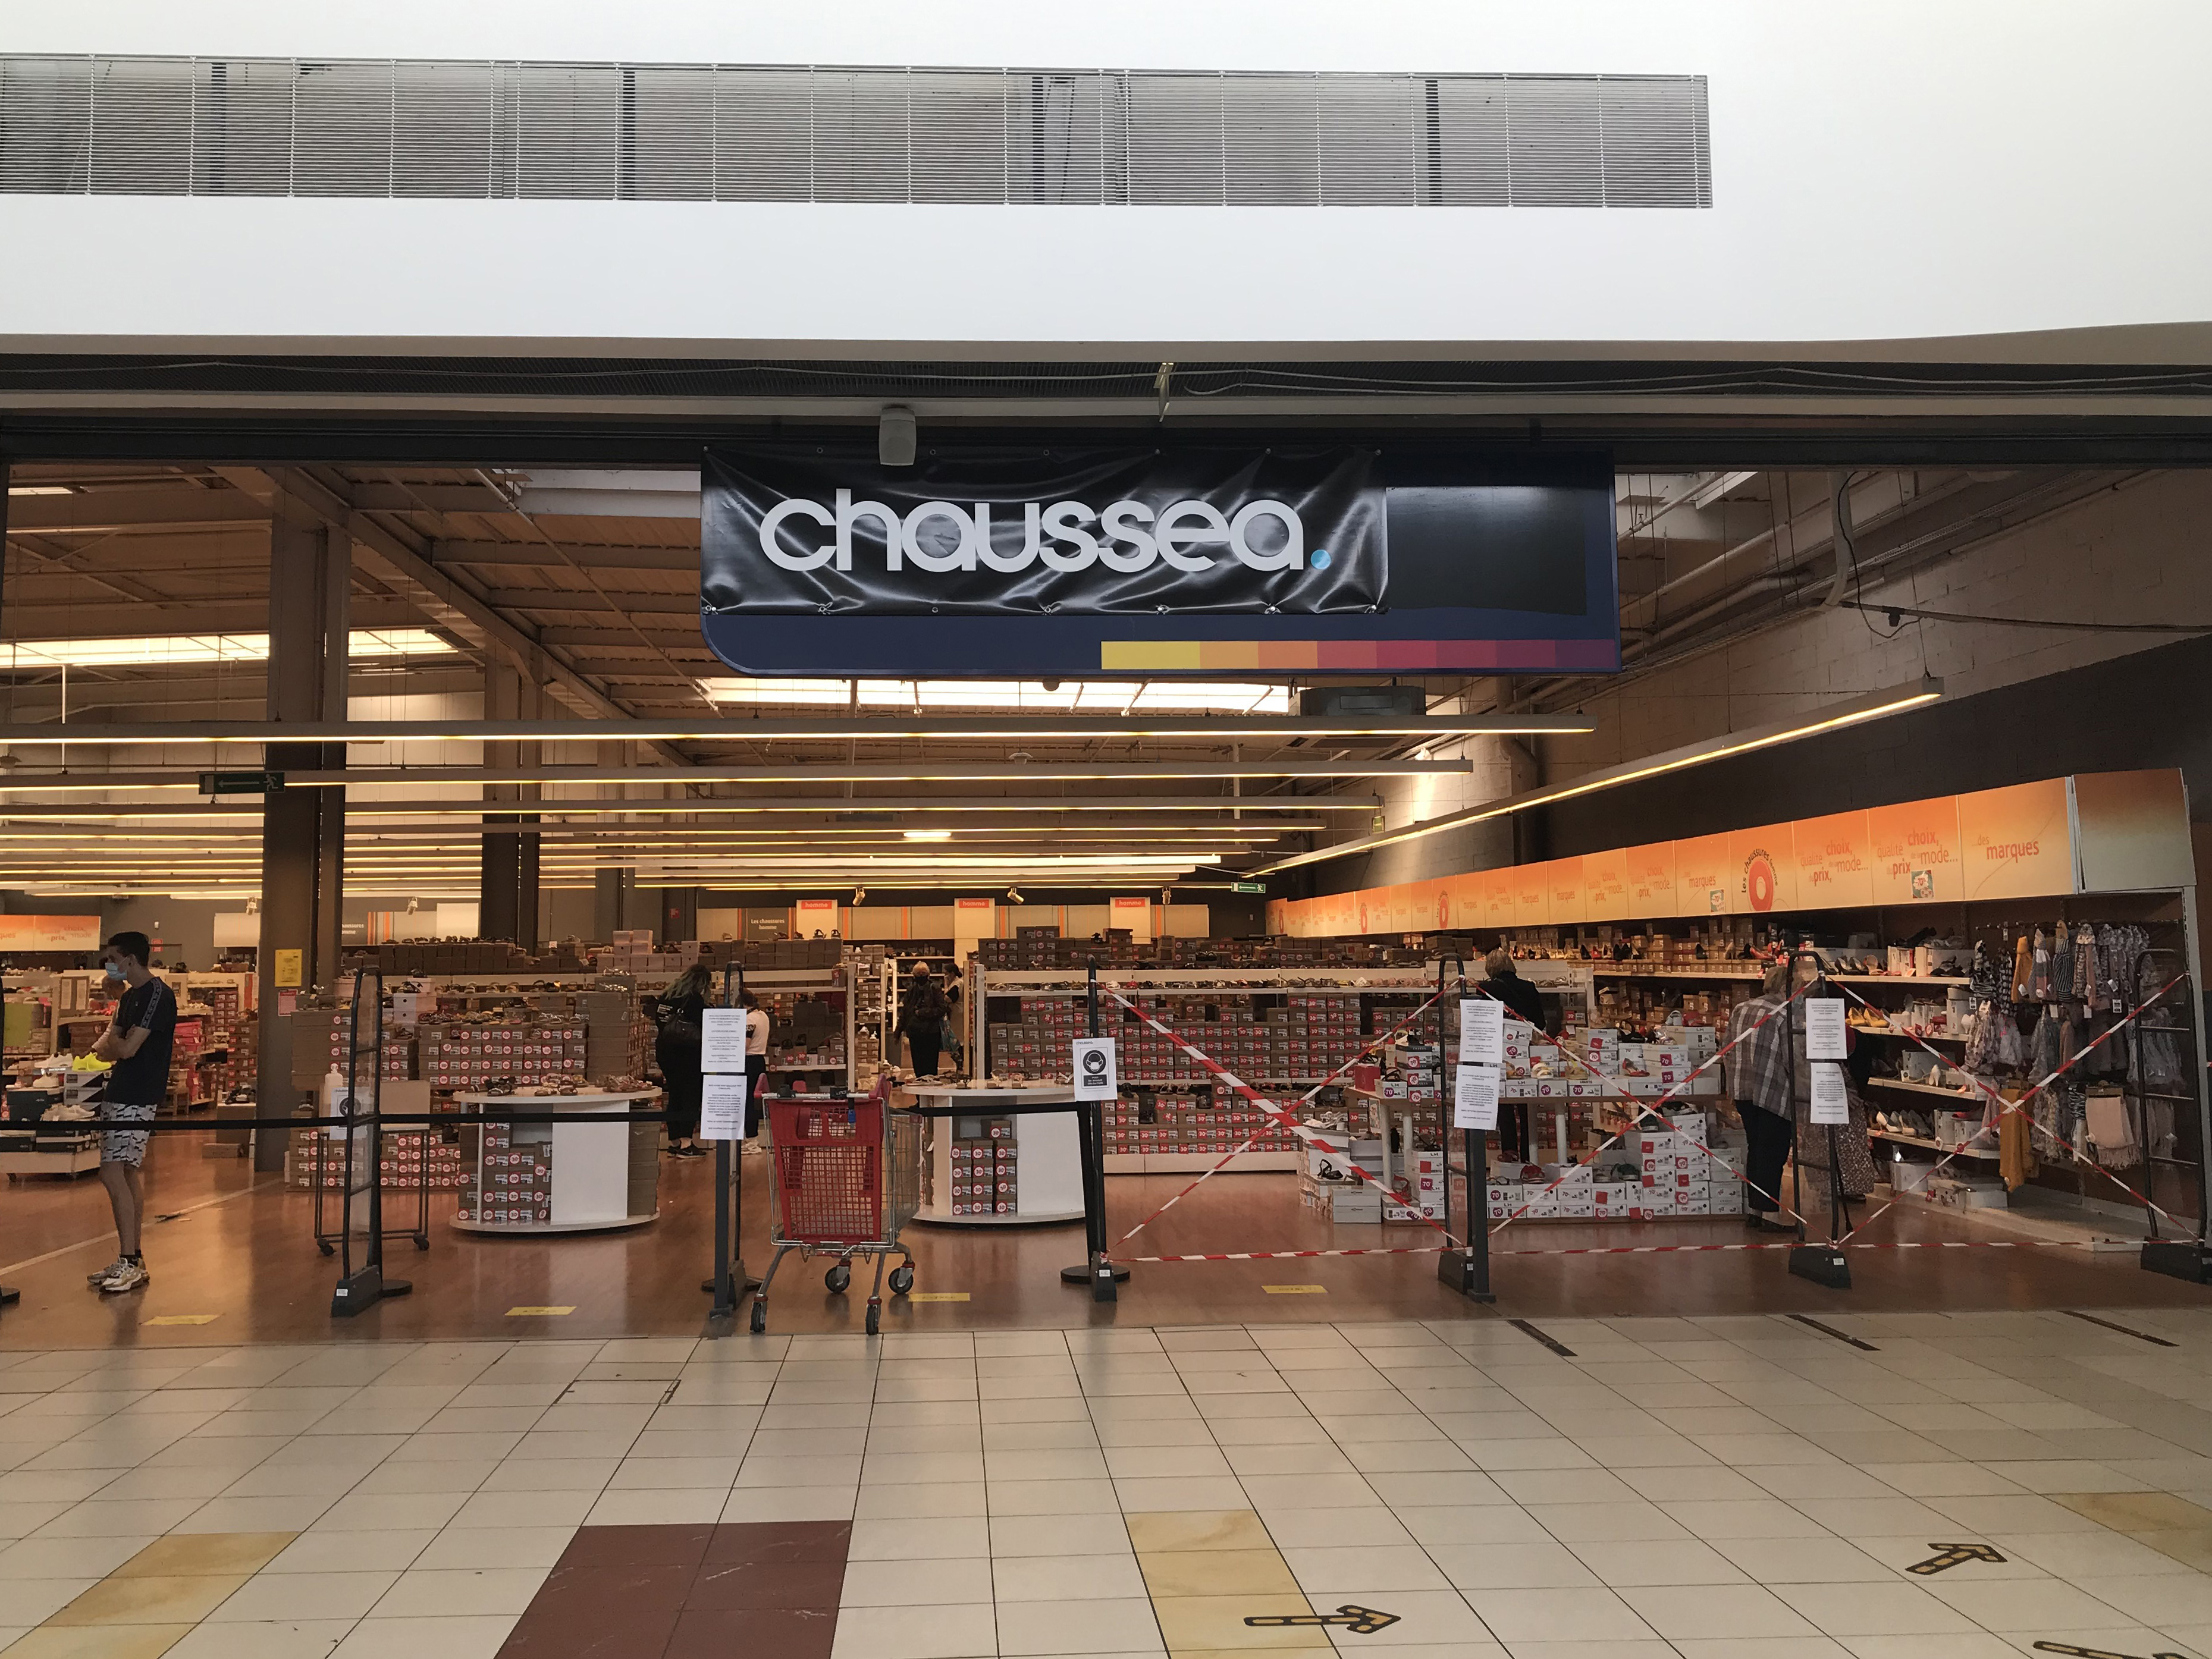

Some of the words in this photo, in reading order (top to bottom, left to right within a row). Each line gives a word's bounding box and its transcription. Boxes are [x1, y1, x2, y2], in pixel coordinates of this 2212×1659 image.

[1908, 827, 1939, 847] choix,
[1826, 838, 1853, 856] choix,
[1877, 843, 1903, 862] qualité
[1987, 841, 2039, 863] marques
[1744, 848, 1770, 874] chaussures
[1689, 875, 1717, 891] marques
[1813, 867, 1832, 886] prix,
